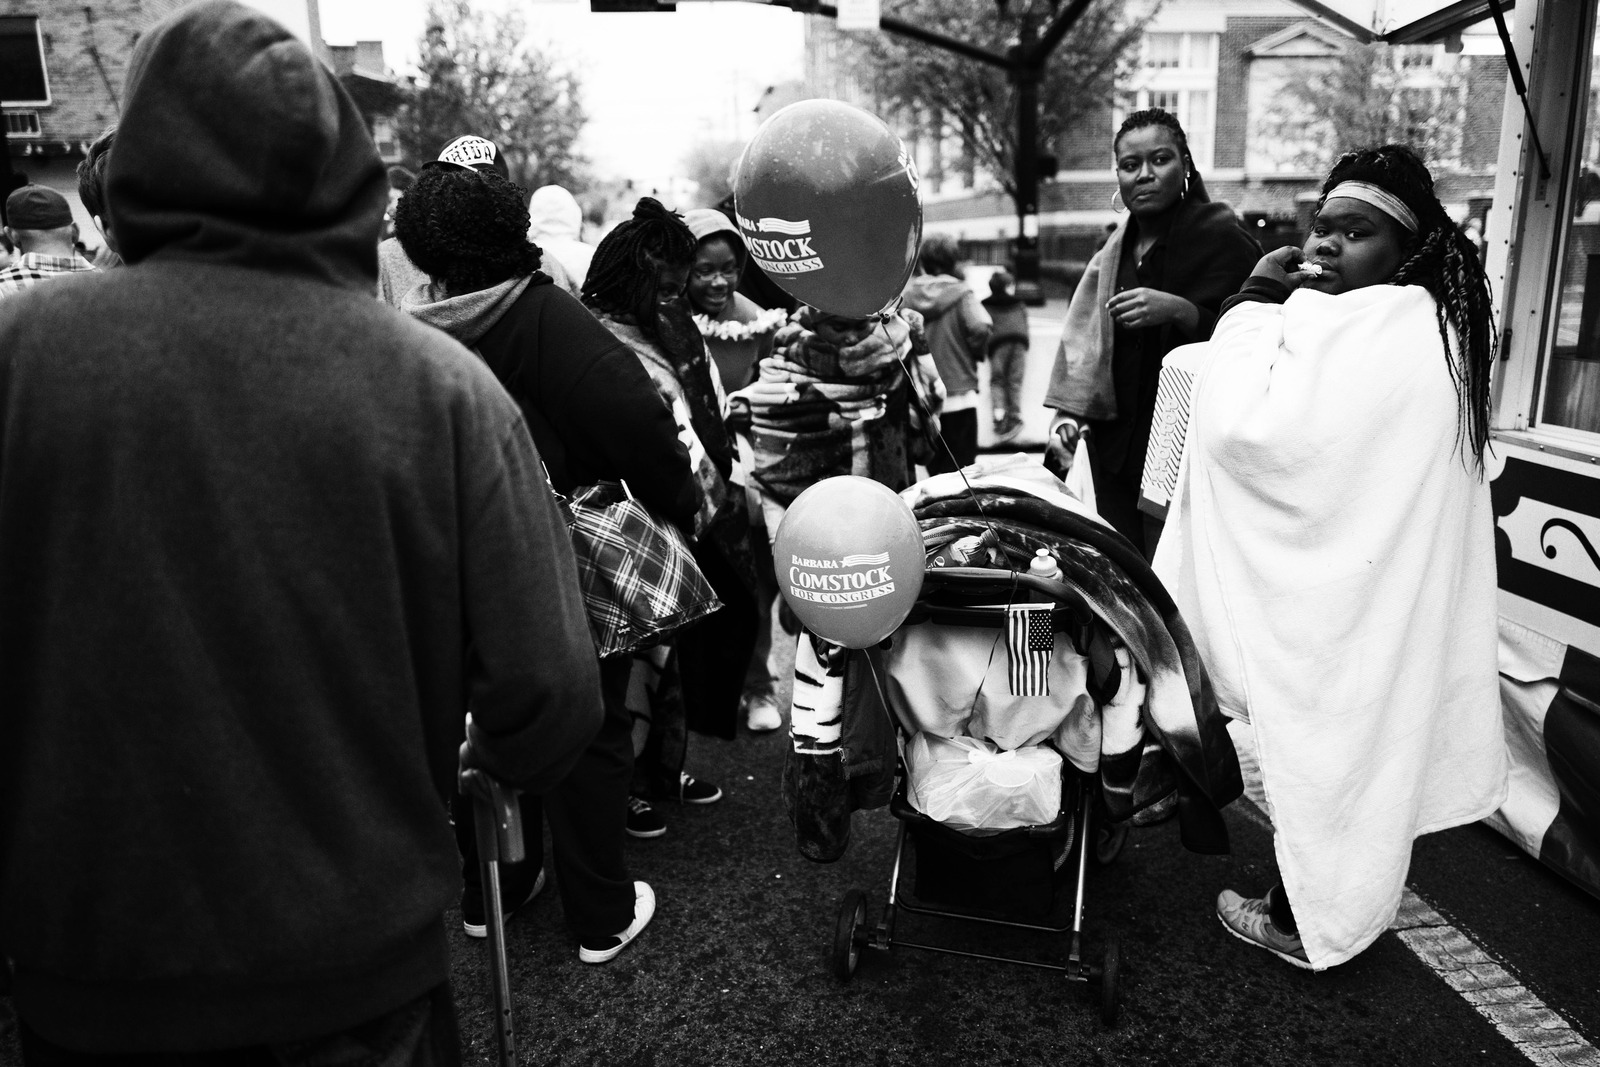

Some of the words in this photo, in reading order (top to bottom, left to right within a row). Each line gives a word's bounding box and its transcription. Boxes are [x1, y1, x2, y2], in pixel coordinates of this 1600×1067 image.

[1151, 398, 1179, 483] POPCORN
[791, 554, 839, 569] BARBARA
[789, 565, 893, 591] COMSTOCK
[792, 586, 815, 601] FOR
[820, 585, 893, 603] CONGRESS
